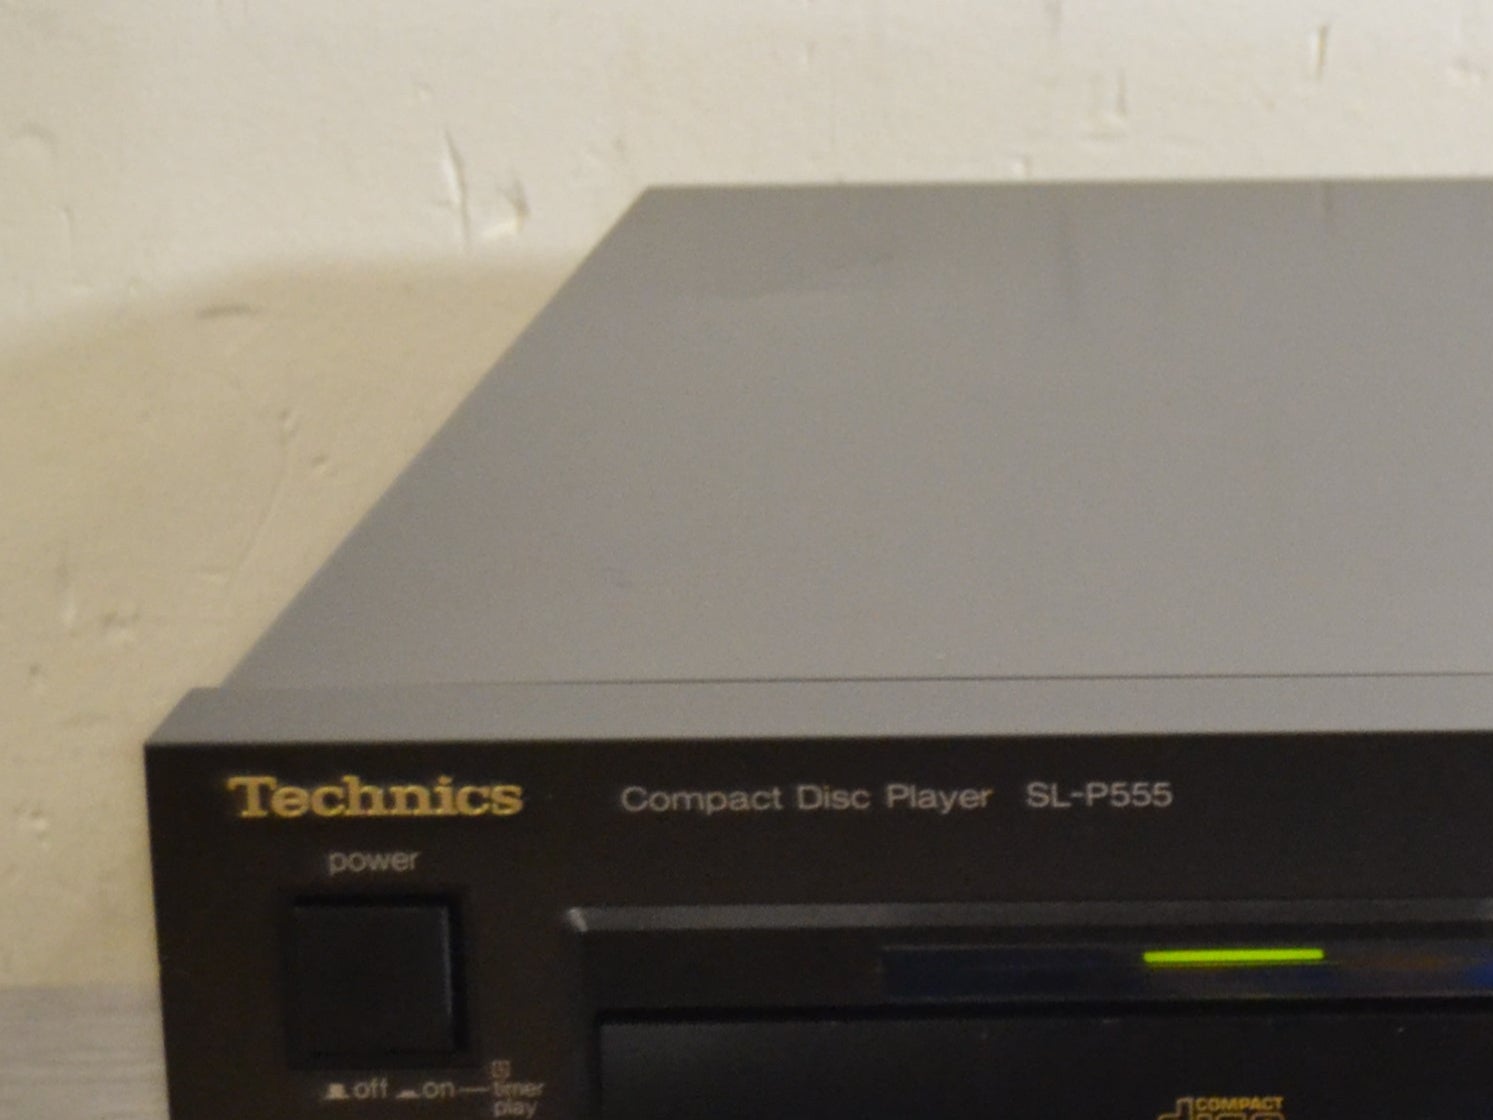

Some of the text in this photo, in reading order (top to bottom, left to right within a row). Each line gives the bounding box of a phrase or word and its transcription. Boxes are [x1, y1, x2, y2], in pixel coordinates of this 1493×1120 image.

[226, 775, 525, 818] Technics
[620, 782, 993, 813] Compact Disc Player
[1025, 780, 1174, 808] SL-P555
[329, 851, 420, 874] power
[353, 1080, 388, 1097] off
[422, 1082, 455, 1098] on
[493, 1080, 544, 1097] timer
[493, 1099, 537, 1118] play
[1195, 1097, 1284, 1111] COMPACT
